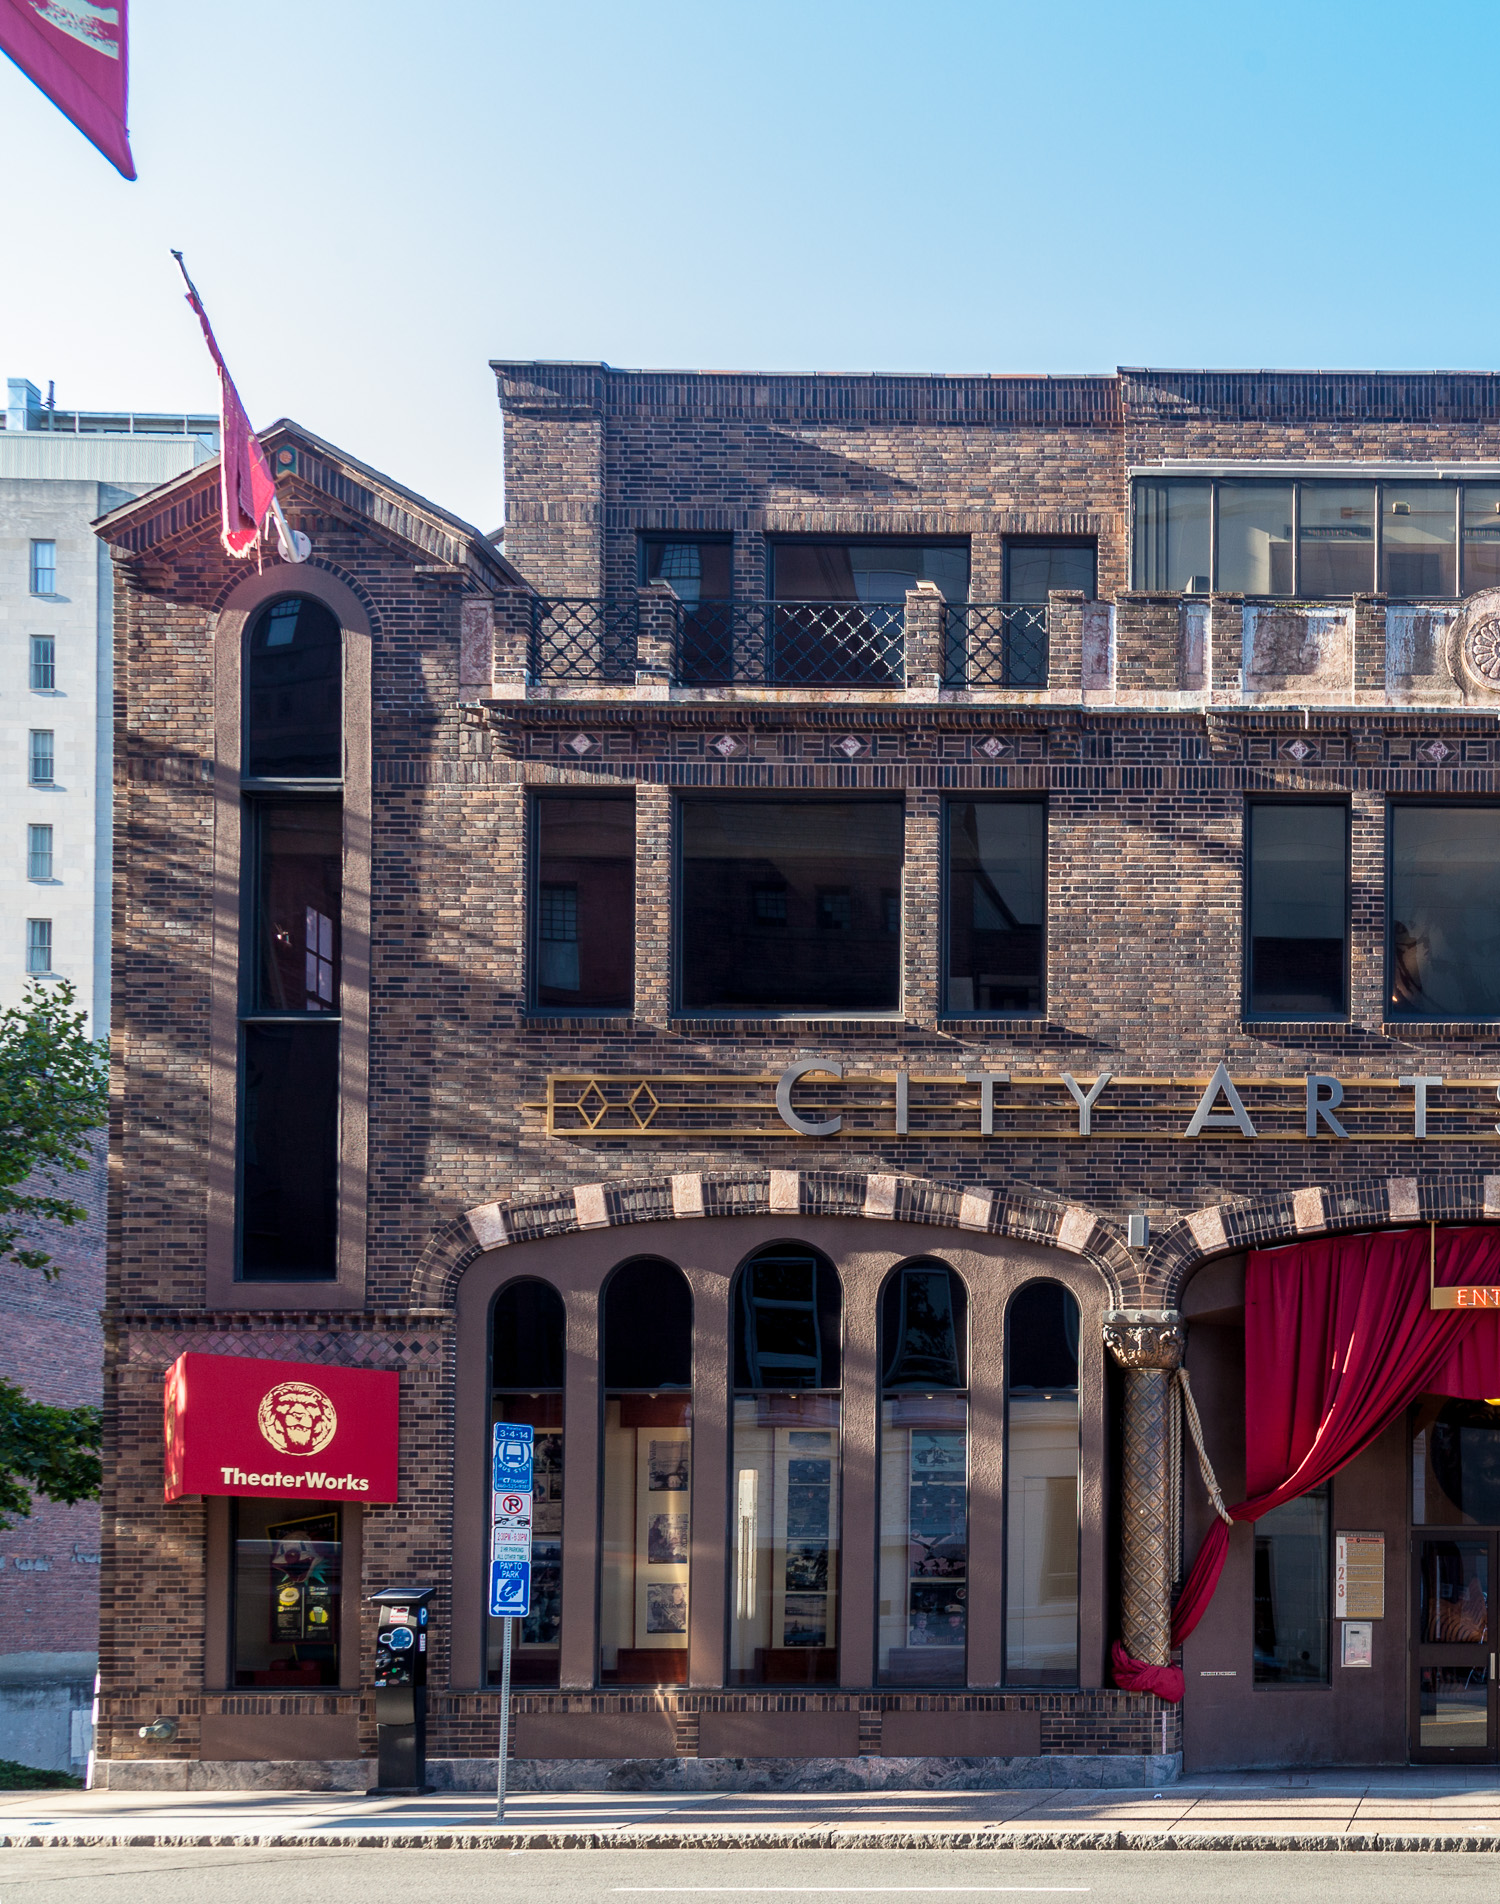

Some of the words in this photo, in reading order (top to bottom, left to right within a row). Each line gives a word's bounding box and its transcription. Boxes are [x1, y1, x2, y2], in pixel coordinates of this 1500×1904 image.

[775, 1058, 1114, 1136] CITY
[498, 1463, 511, 1473] BUS
[513, 1463, 530, 1474] STOP
[220, 1467, 370, 1491] TheaterWorks
[1339, 1545, 1344, 1559] 1
[500, 1562, 513, 1570] PAY
[513, 1562, 523, 1571] TO
[1338, 1566, 1345, 1580] 2
[501, 1570, 520, 1579] PARK
[1338, 1584, 1345, 1598] 3
